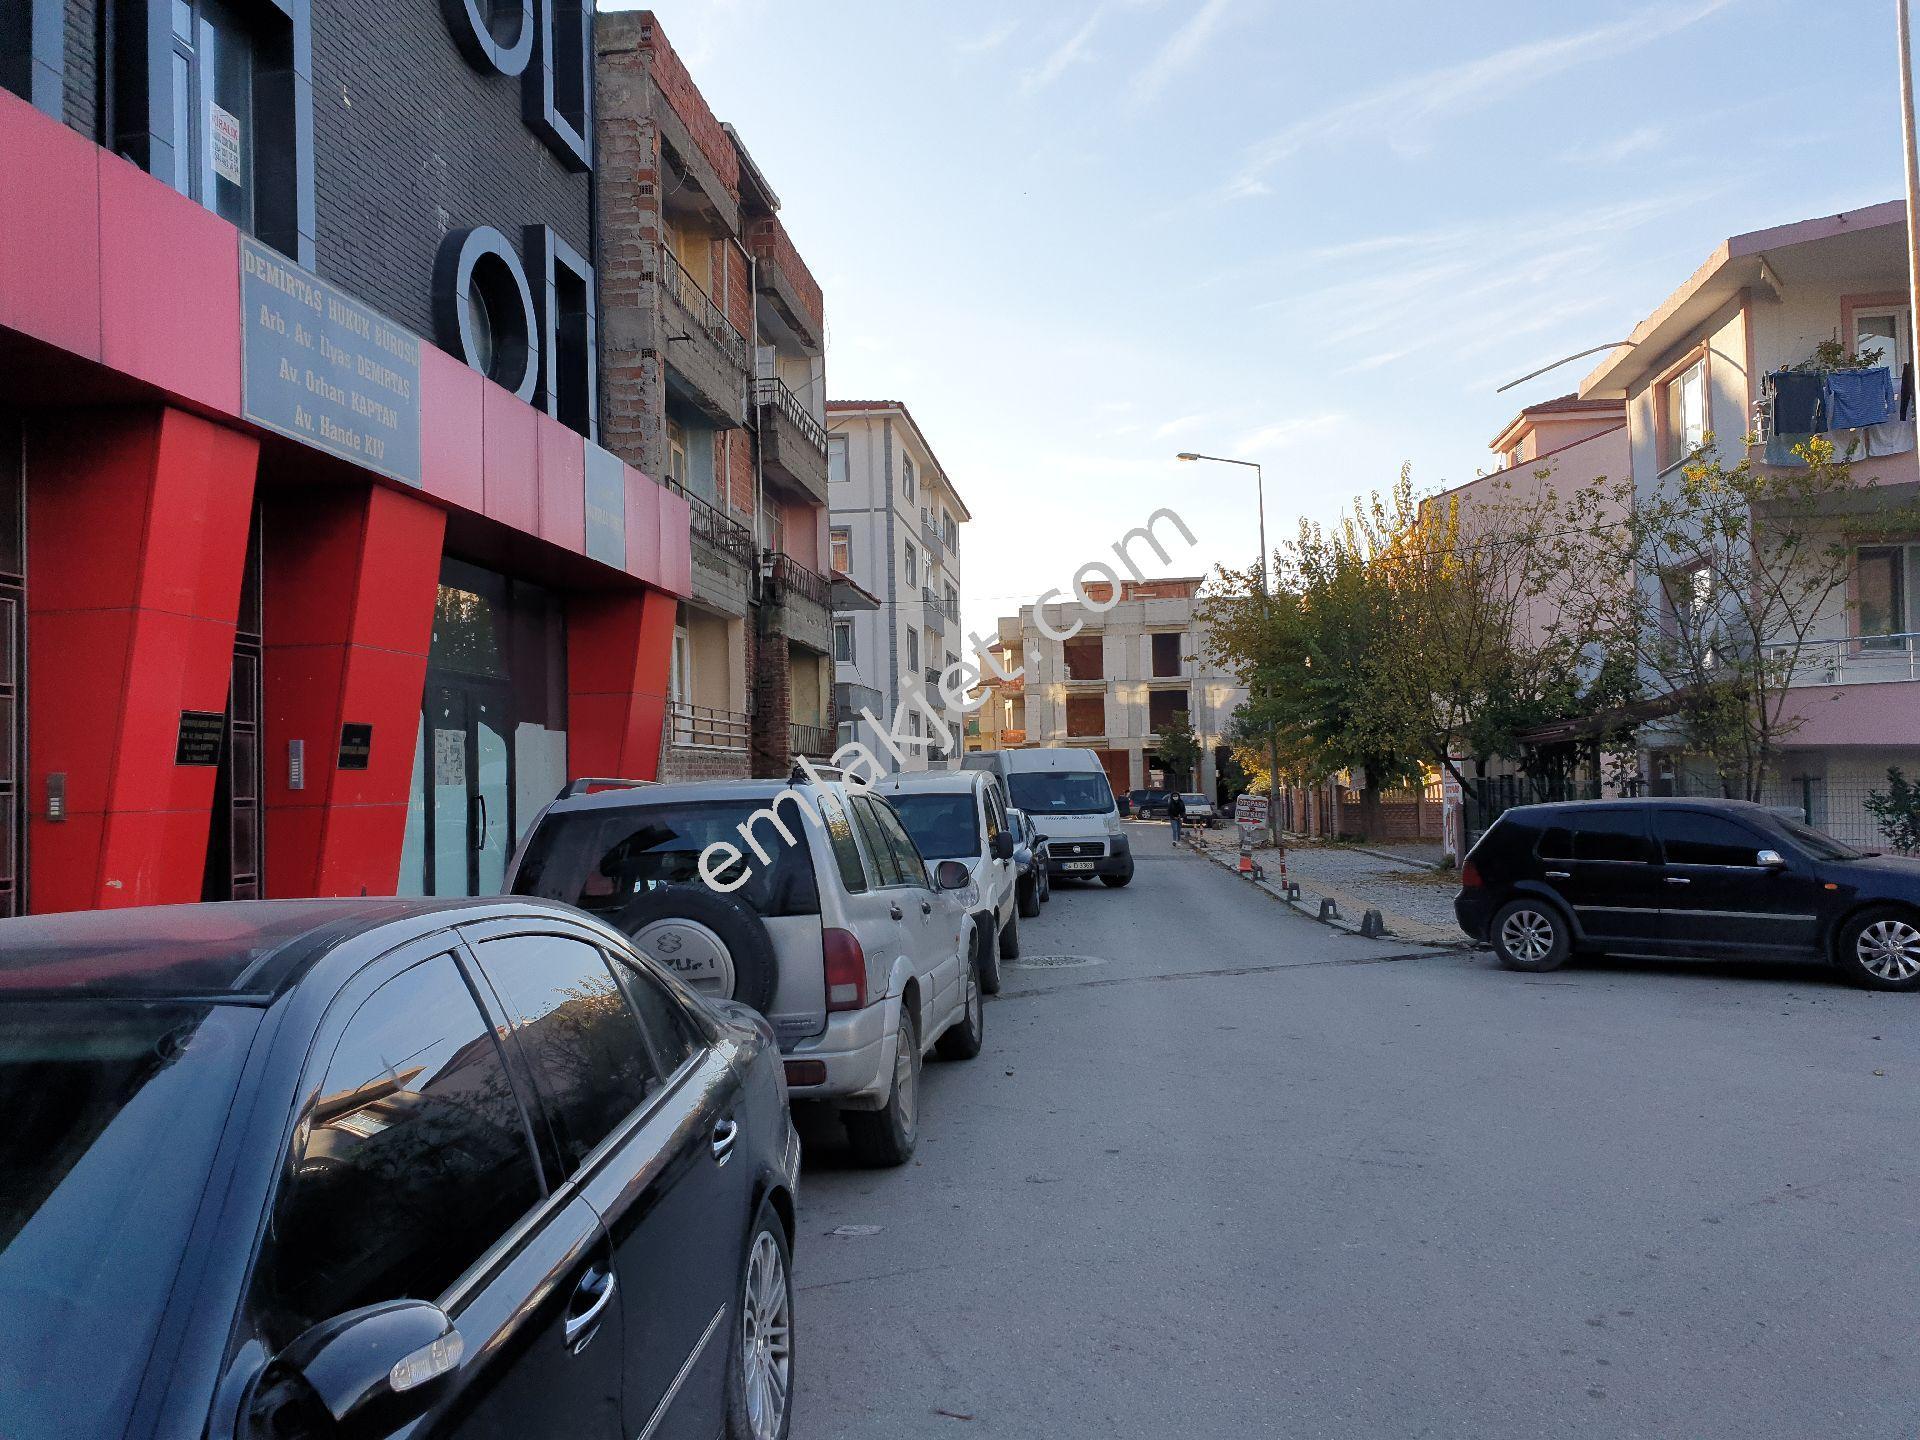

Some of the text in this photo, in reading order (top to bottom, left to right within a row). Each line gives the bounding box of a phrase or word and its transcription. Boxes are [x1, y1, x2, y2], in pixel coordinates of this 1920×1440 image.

[245, 249, 418, 367] DEMİRTAŞ HUKUK BÜROSU
[259, 303, 290, 339] Arb.
[294, 321, 315, 351] Av.
[320, 330, 351, 373] İlyas
[279, 356, 398, 431] Av. Orhan KAPTAN
[295, 404, 315, 432] Av.
[320, 415, 361, 451] Hande
